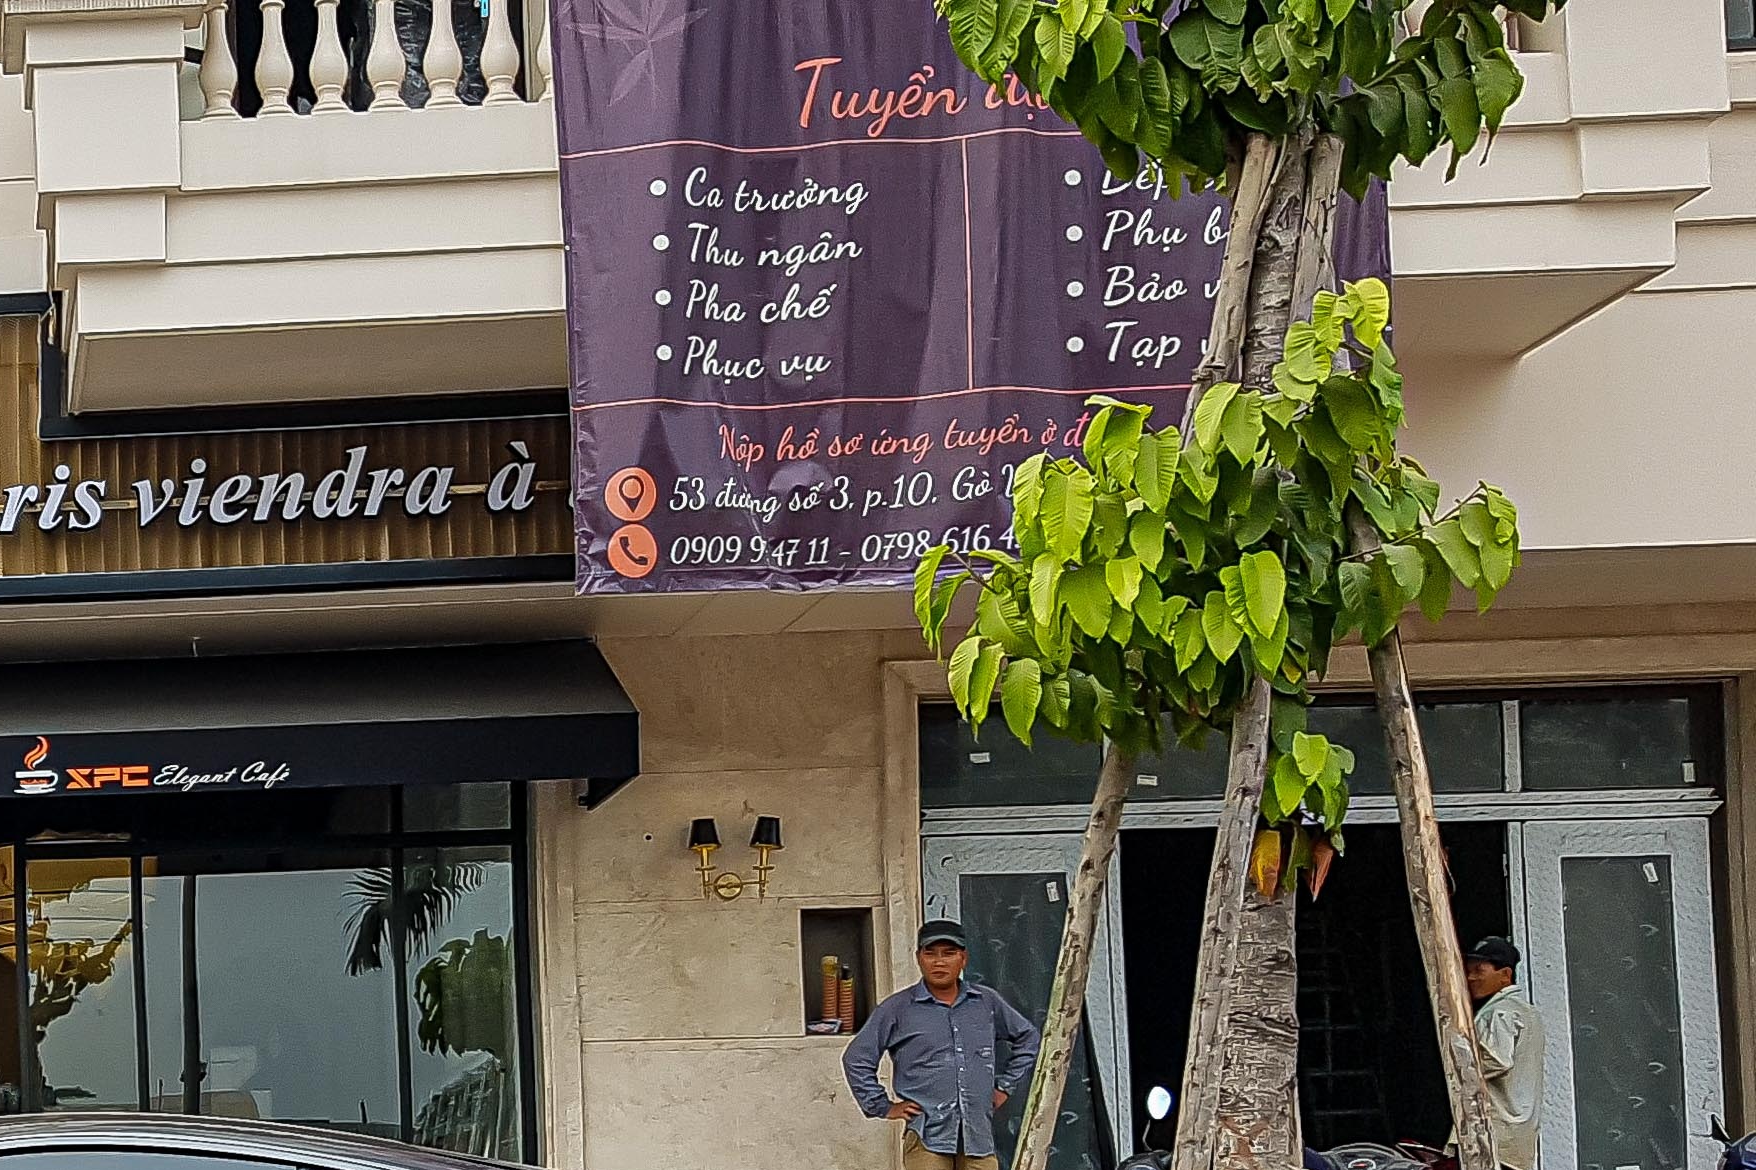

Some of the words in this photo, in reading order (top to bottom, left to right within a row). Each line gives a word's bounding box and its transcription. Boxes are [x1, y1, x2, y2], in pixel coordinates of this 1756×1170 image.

[795, 57, 970, 138] Tuyển
[685, 167, 723, 208] Ca
[734, 178, 869, 214] trưởng
[687, 222, 744, 267] Thu
[757, 232, 863, 277] ngân
[1102, 207, 1187, 252] Phụ
[685, 279, 746, 322] Pha
[760, 283, 837, 323] chế
[1103, 265, 1187, 307] Bảo
[683, 336, 764, 384] Phục
[780, 354, 832, 381] vụ
[1104, 320, 1181, 368] Tạp
[719, 423, 765, 472] Nộp
[776, 426, 820, 463] hồ
[827, 433, 863, 457] sơ
[871, 428, 934, 463] ứng
[944, 413, 1033, 455] tuyển
[1040, 418, 1059, 446] ở
[132, 445, 456, 527] viendra
[484, 441, 537, 511] à
[669, 476, 706, 511] 53
[788, 481, 824, 512] số
[952, 466, 993, 501] Gò
[670, 535, 742, 565] 0909
[804, 536, 830, 565] 11
[860, 529, 931, 562] 0798
[941, 523, 991, 554] 616
[65, 765, 149, 790] SPC
[153, 764, 238, 792] Elegant
[241, 760, 291, 789] Café
